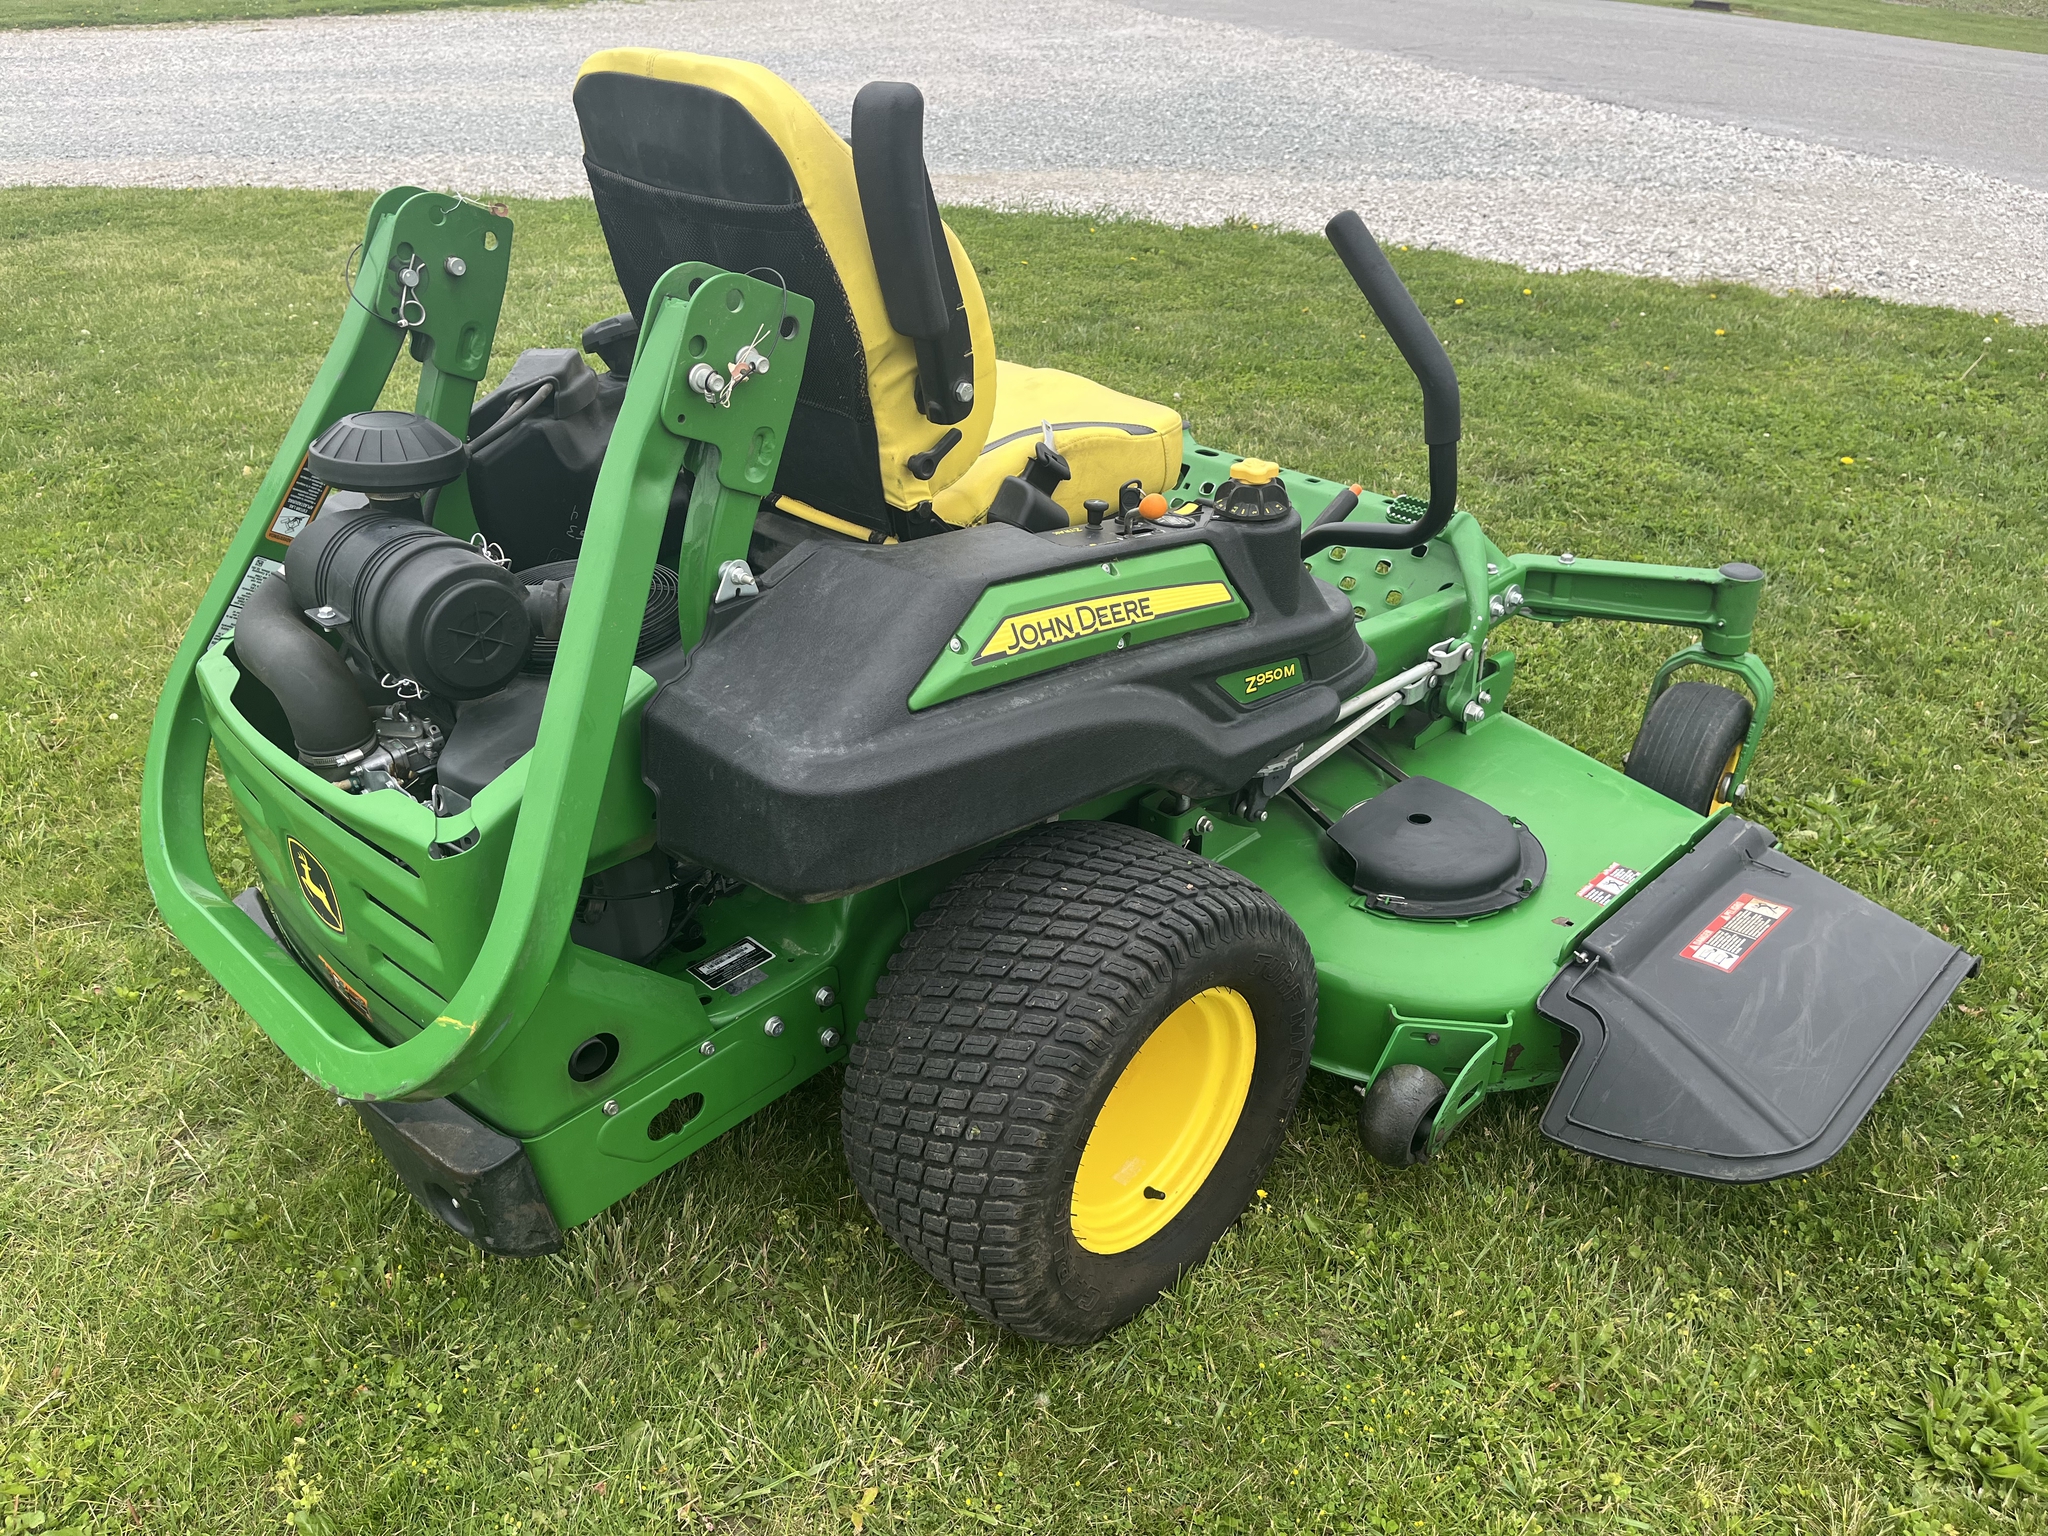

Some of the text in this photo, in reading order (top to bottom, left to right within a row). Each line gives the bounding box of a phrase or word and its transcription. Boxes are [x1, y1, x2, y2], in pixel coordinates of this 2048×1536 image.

[1008, 596, 1154, 651] JOHN DEERE
[1244, 663, 1296, 694] Z950M
[1248, 952, 1304, 1002] TURF
